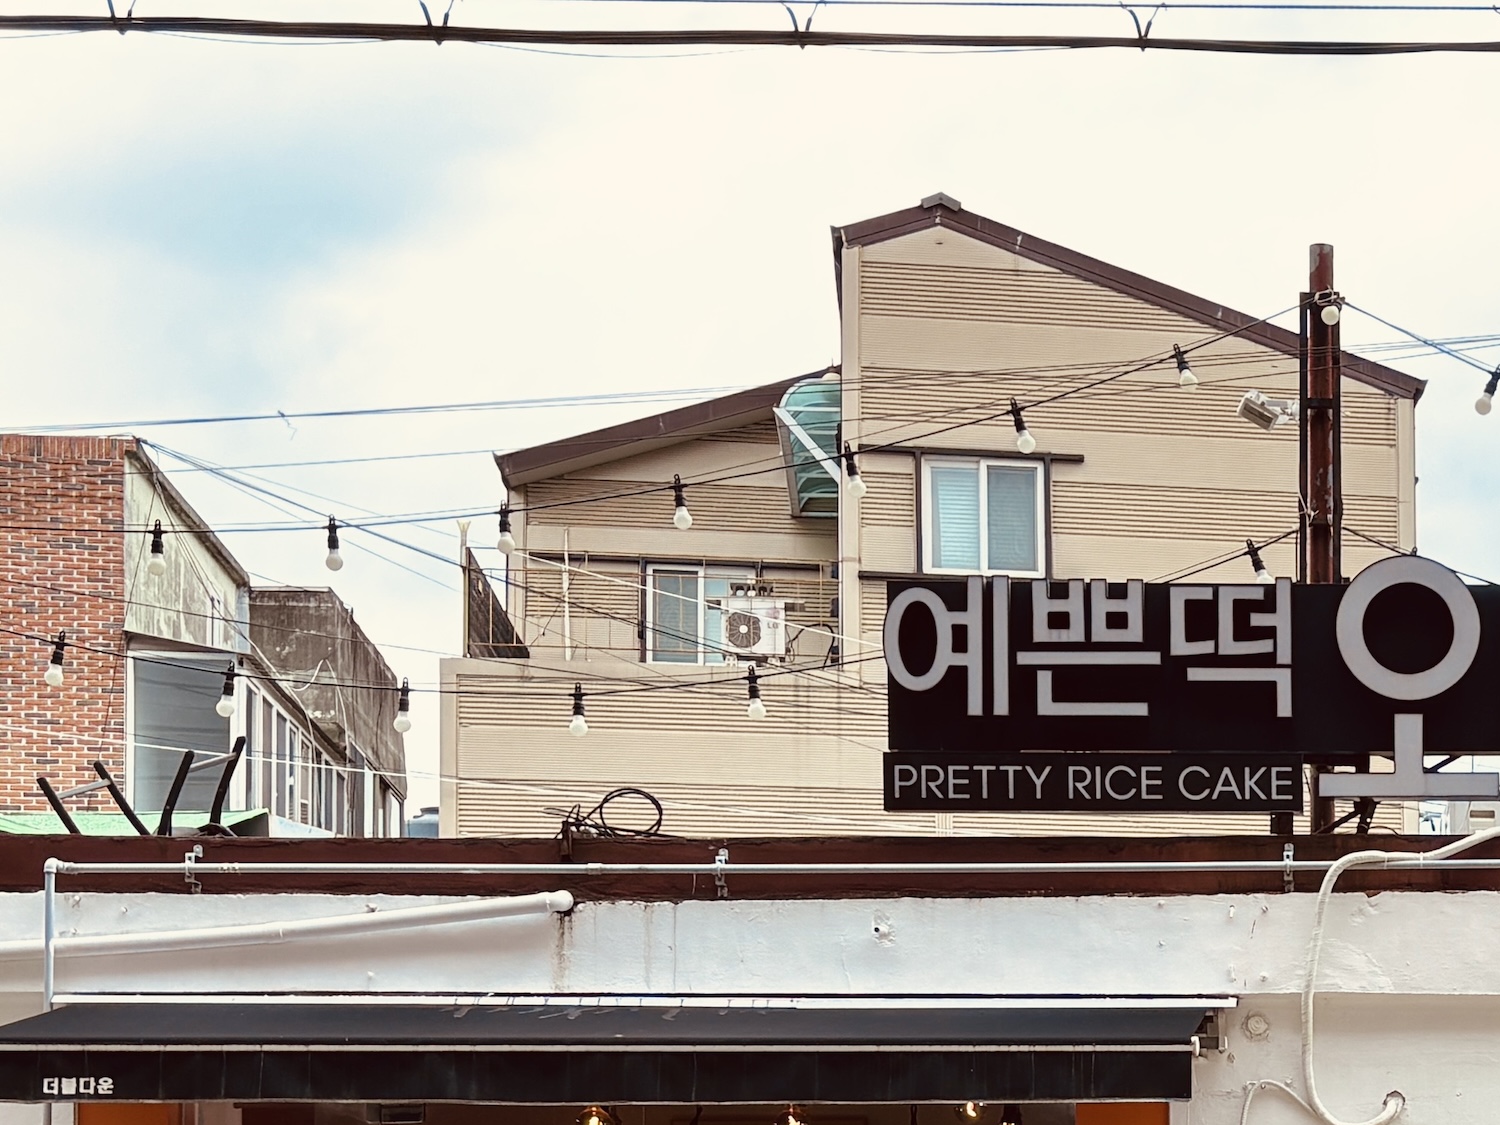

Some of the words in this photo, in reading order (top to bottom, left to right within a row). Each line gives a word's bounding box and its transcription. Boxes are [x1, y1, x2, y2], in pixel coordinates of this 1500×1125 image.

[884, 575, 1293, 717] 예쁜떡
[893, 766, 1049, 801] PRETTY
[1066, 766, 1163, 801] RICE
[1178, 766, 1294, 801] CAKE
[42, 1076, 115, 1096] 더블다운
